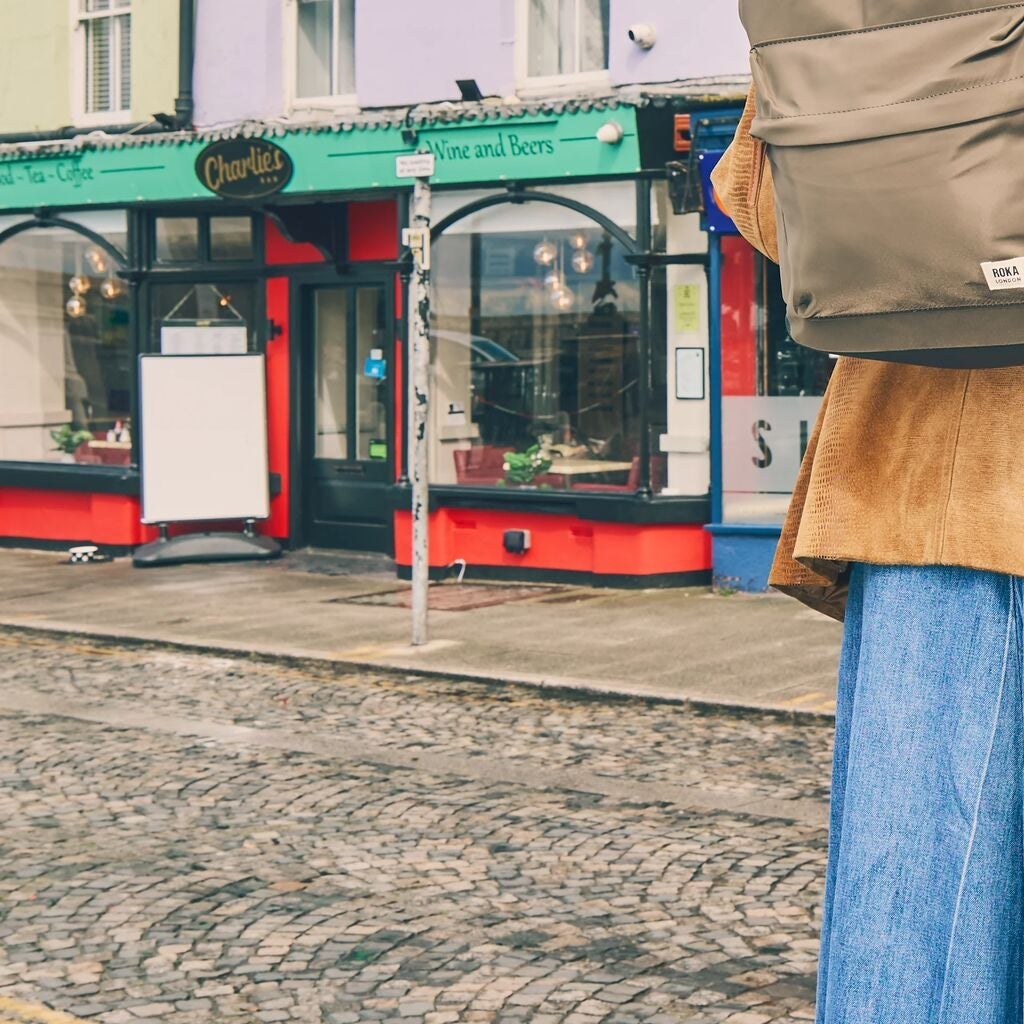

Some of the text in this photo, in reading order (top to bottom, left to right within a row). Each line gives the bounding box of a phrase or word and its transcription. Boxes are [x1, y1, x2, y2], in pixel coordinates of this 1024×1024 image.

[426, 132, 554, 160] Wine and Beers
[23, 165, 46, 184] Tea
[56, 161, 95, 188] Coffee
[204, 144, 283, 190] Charlie's
[992, 266, 1019, 277] ROKA
